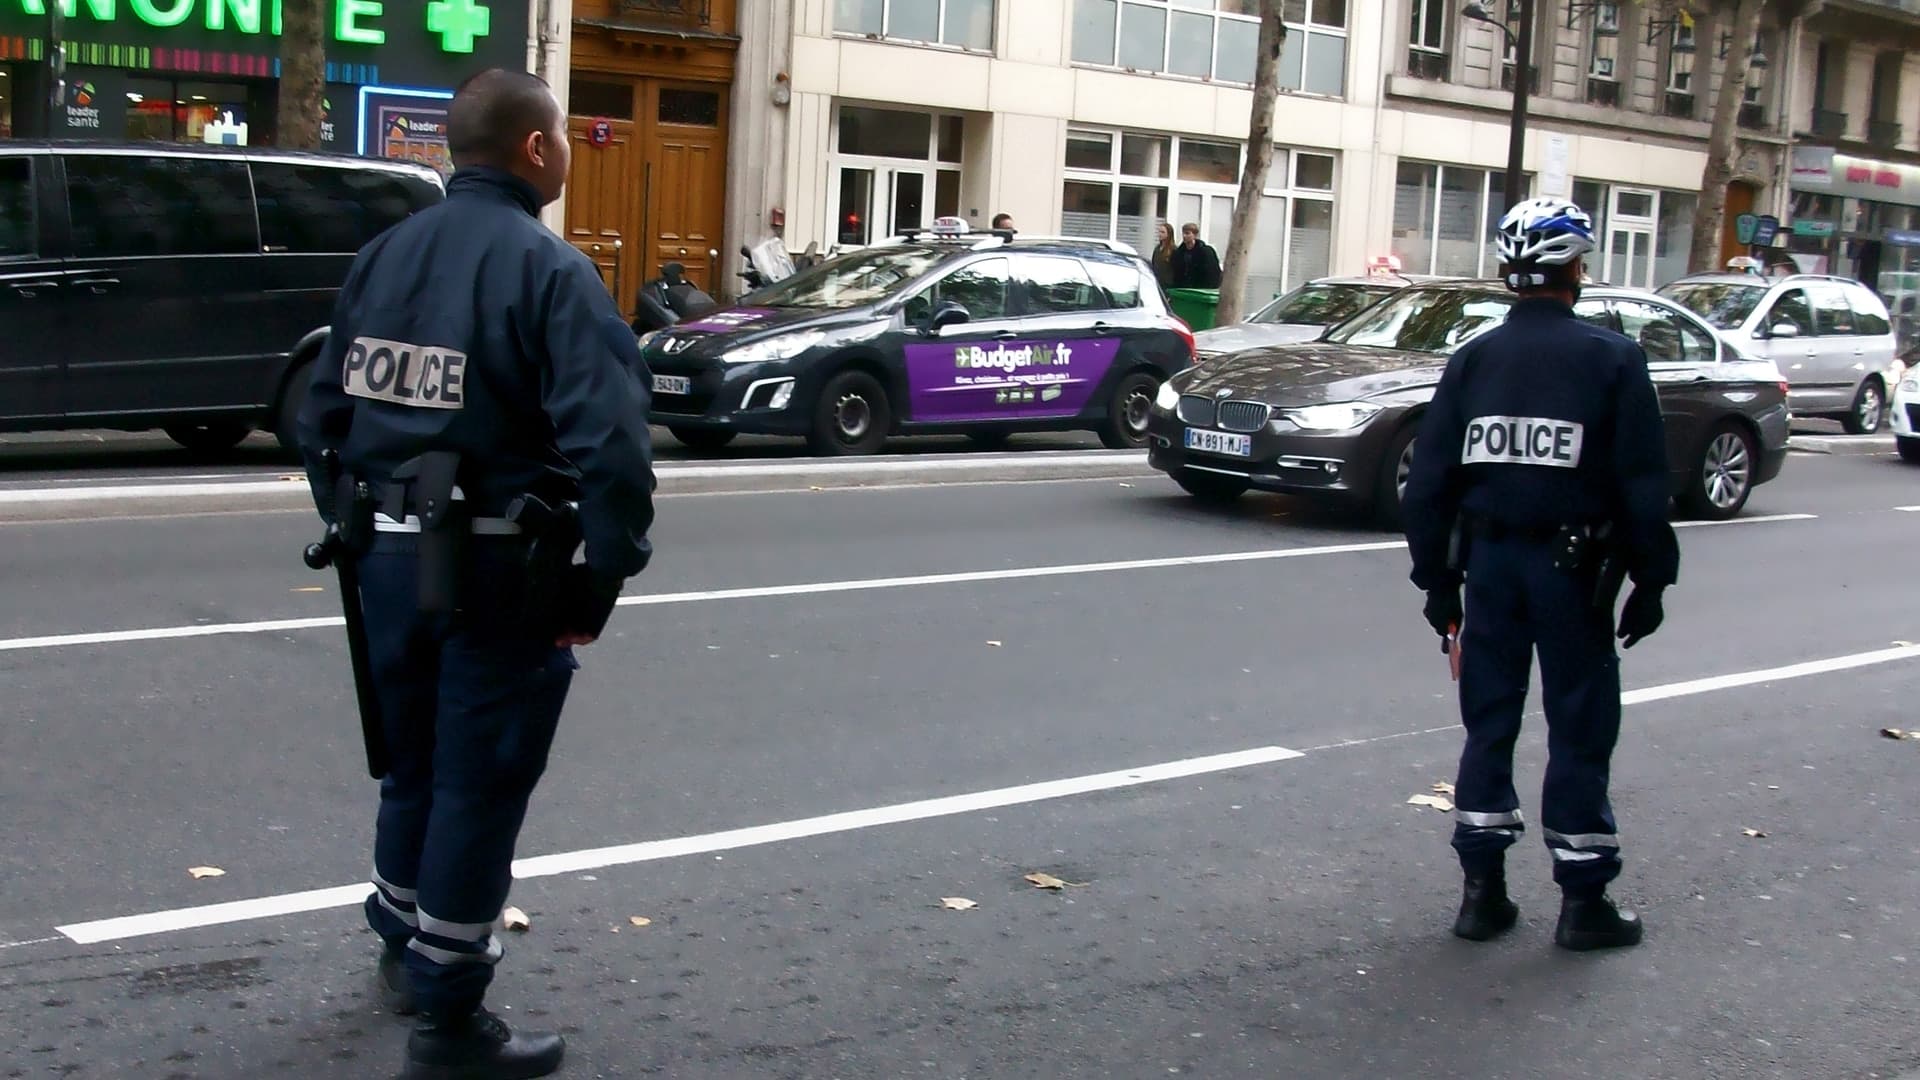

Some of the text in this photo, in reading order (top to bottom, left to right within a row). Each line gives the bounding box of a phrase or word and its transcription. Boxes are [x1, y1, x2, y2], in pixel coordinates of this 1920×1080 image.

[67, 105, 99, 118] leader
[409, 120, 438, 133] leader
[345, 342, 464, 402] POLICE
[970, 342, 1072, 373] BudgetAir.fr
[1467, 422, 1574, 461] POLICE
